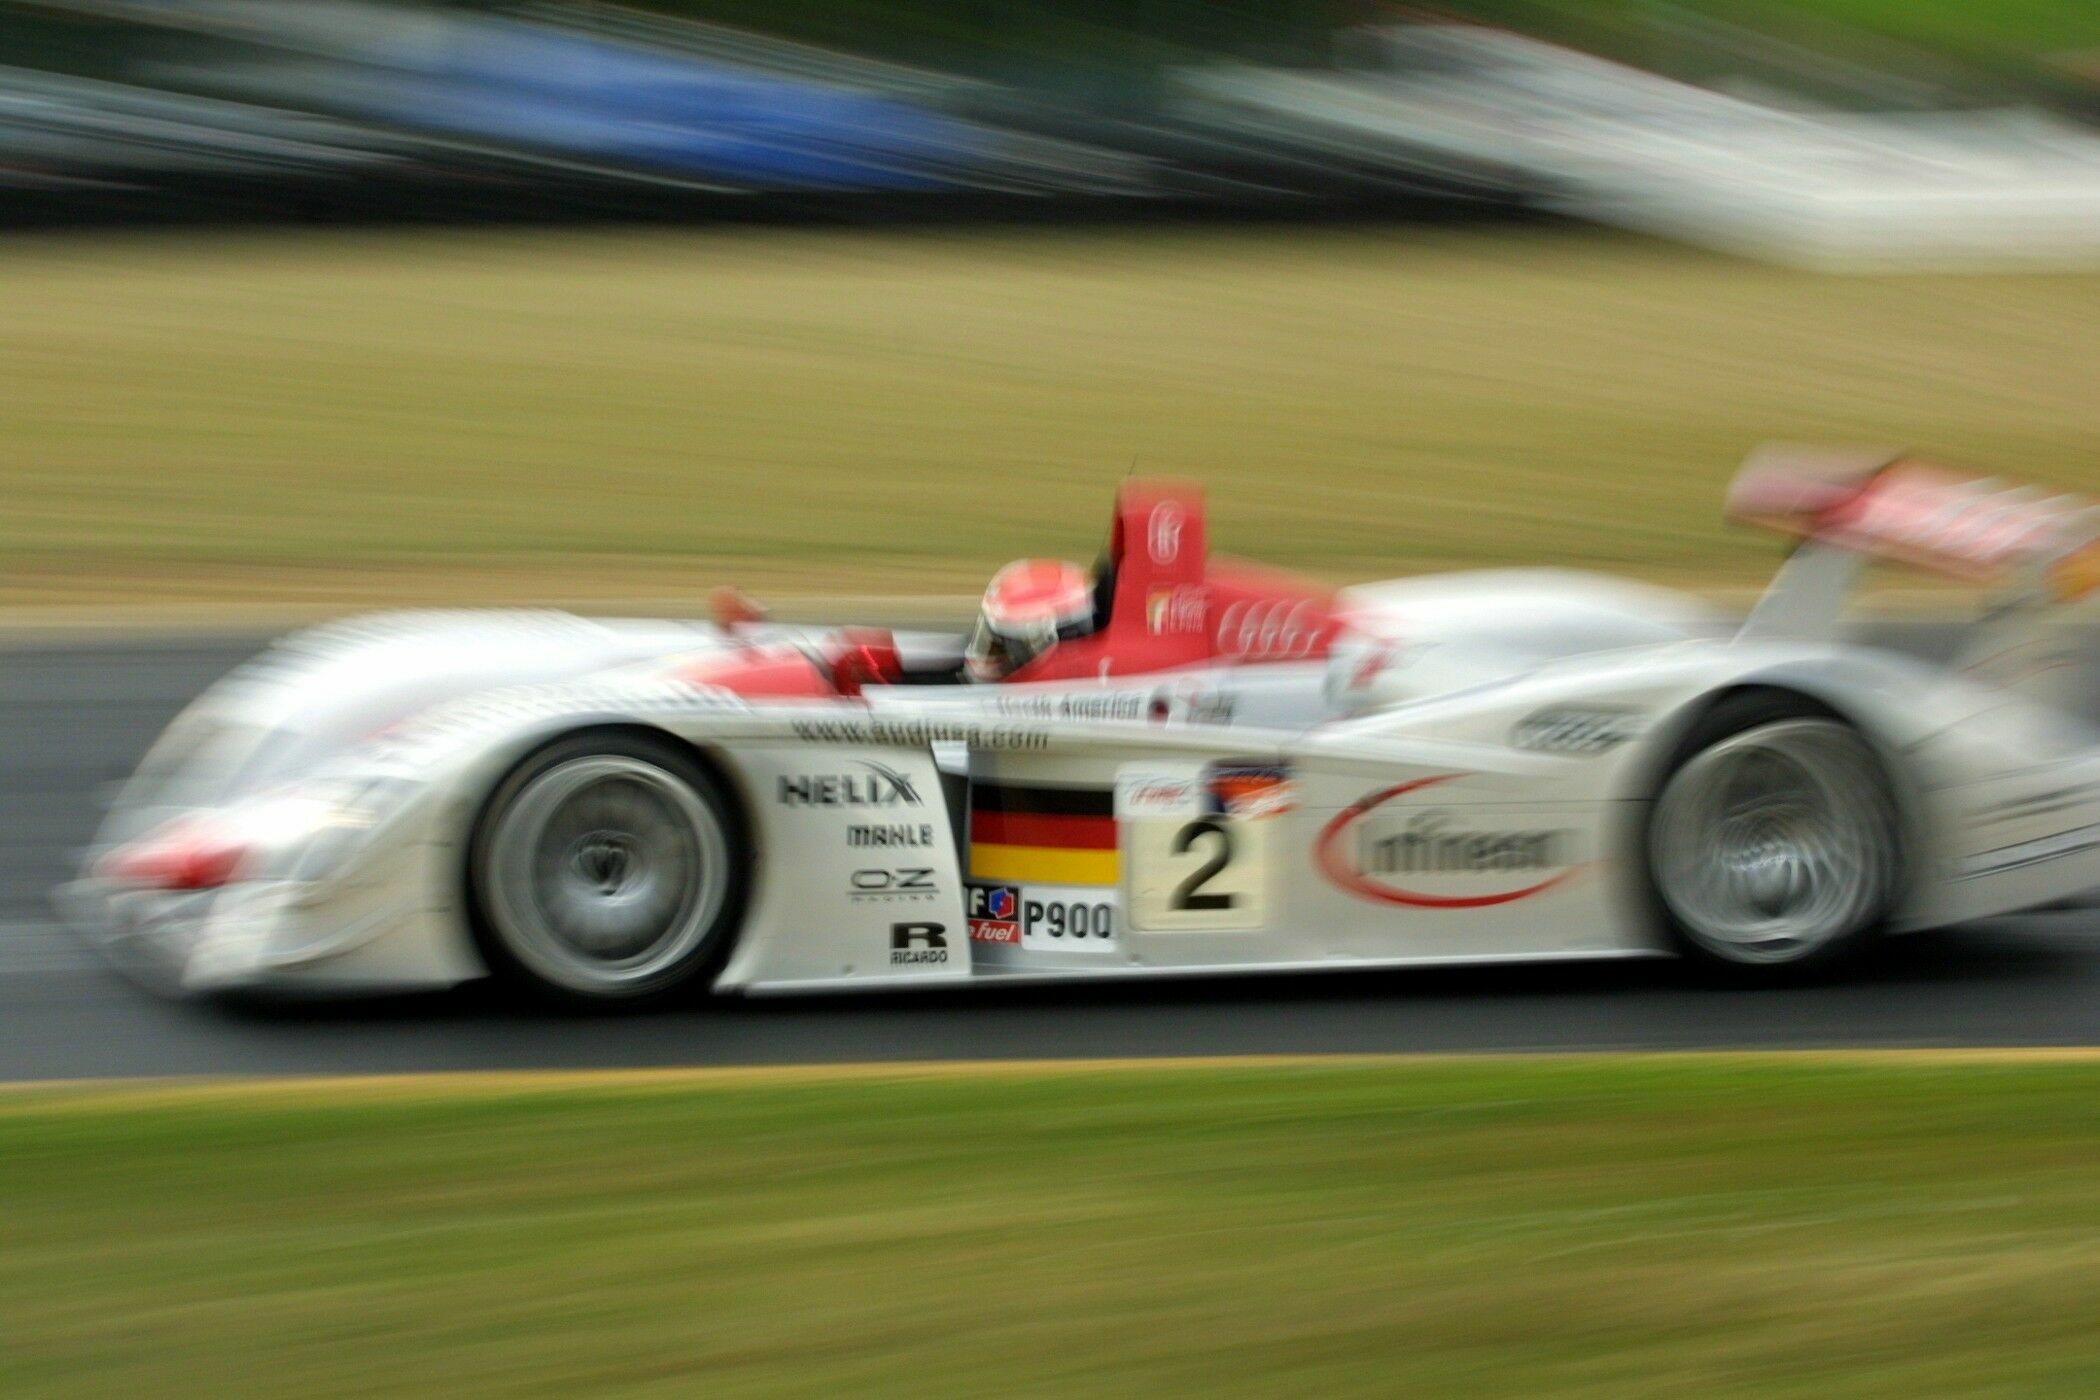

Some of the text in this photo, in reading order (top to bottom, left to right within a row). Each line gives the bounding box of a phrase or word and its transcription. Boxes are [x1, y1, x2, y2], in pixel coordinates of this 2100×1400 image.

[776, 762, 924, 807] HELIX
[847, 824, 933, 846] MAHLE
[1169, 814, 1238, 911] 2
[976, 921, 1016, 941] fuel
[1024, 900, 1112, 938] P900
[890, 922, 948, 949] R
[890, 950, 948, 964] RICARDO
